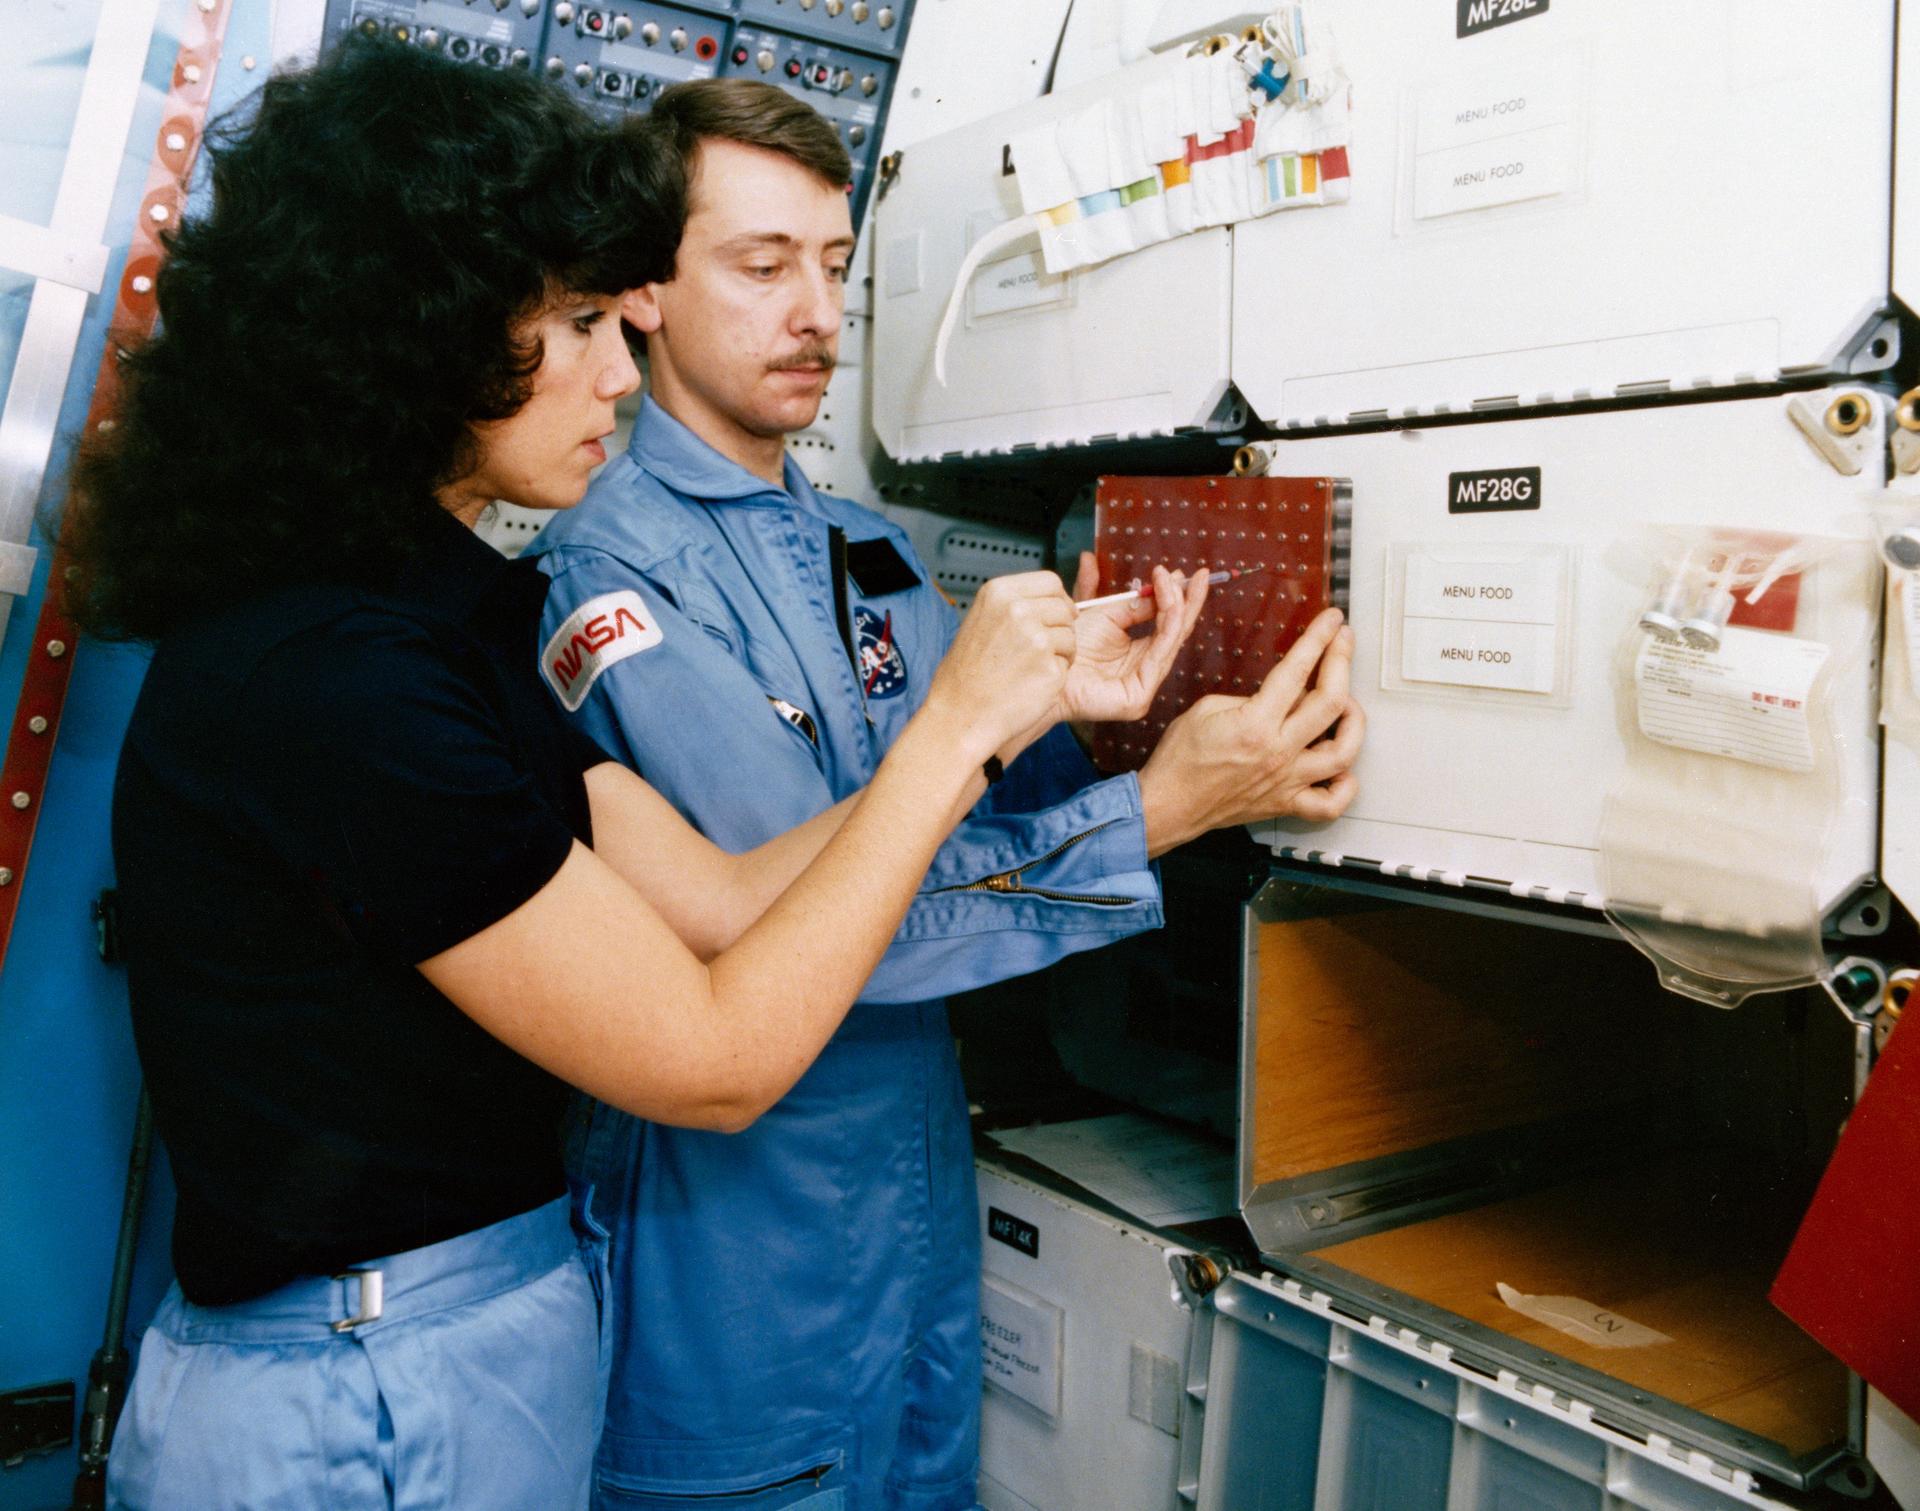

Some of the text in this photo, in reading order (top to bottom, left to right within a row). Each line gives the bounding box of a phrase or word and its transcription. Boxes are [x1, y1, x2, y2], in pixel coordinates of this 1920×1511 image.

[1455, 97, 1526, 125] MENU FOOD
[1453, 162, 1524, 187] MENU FOOD
[1456, 477, 1532, 503] MF28G
[1443, 585, 1513, 599] MENU FOOD
[553, 607, 646, 691] NASA
[1441, 648, 1511, 664] MENU FOOD
